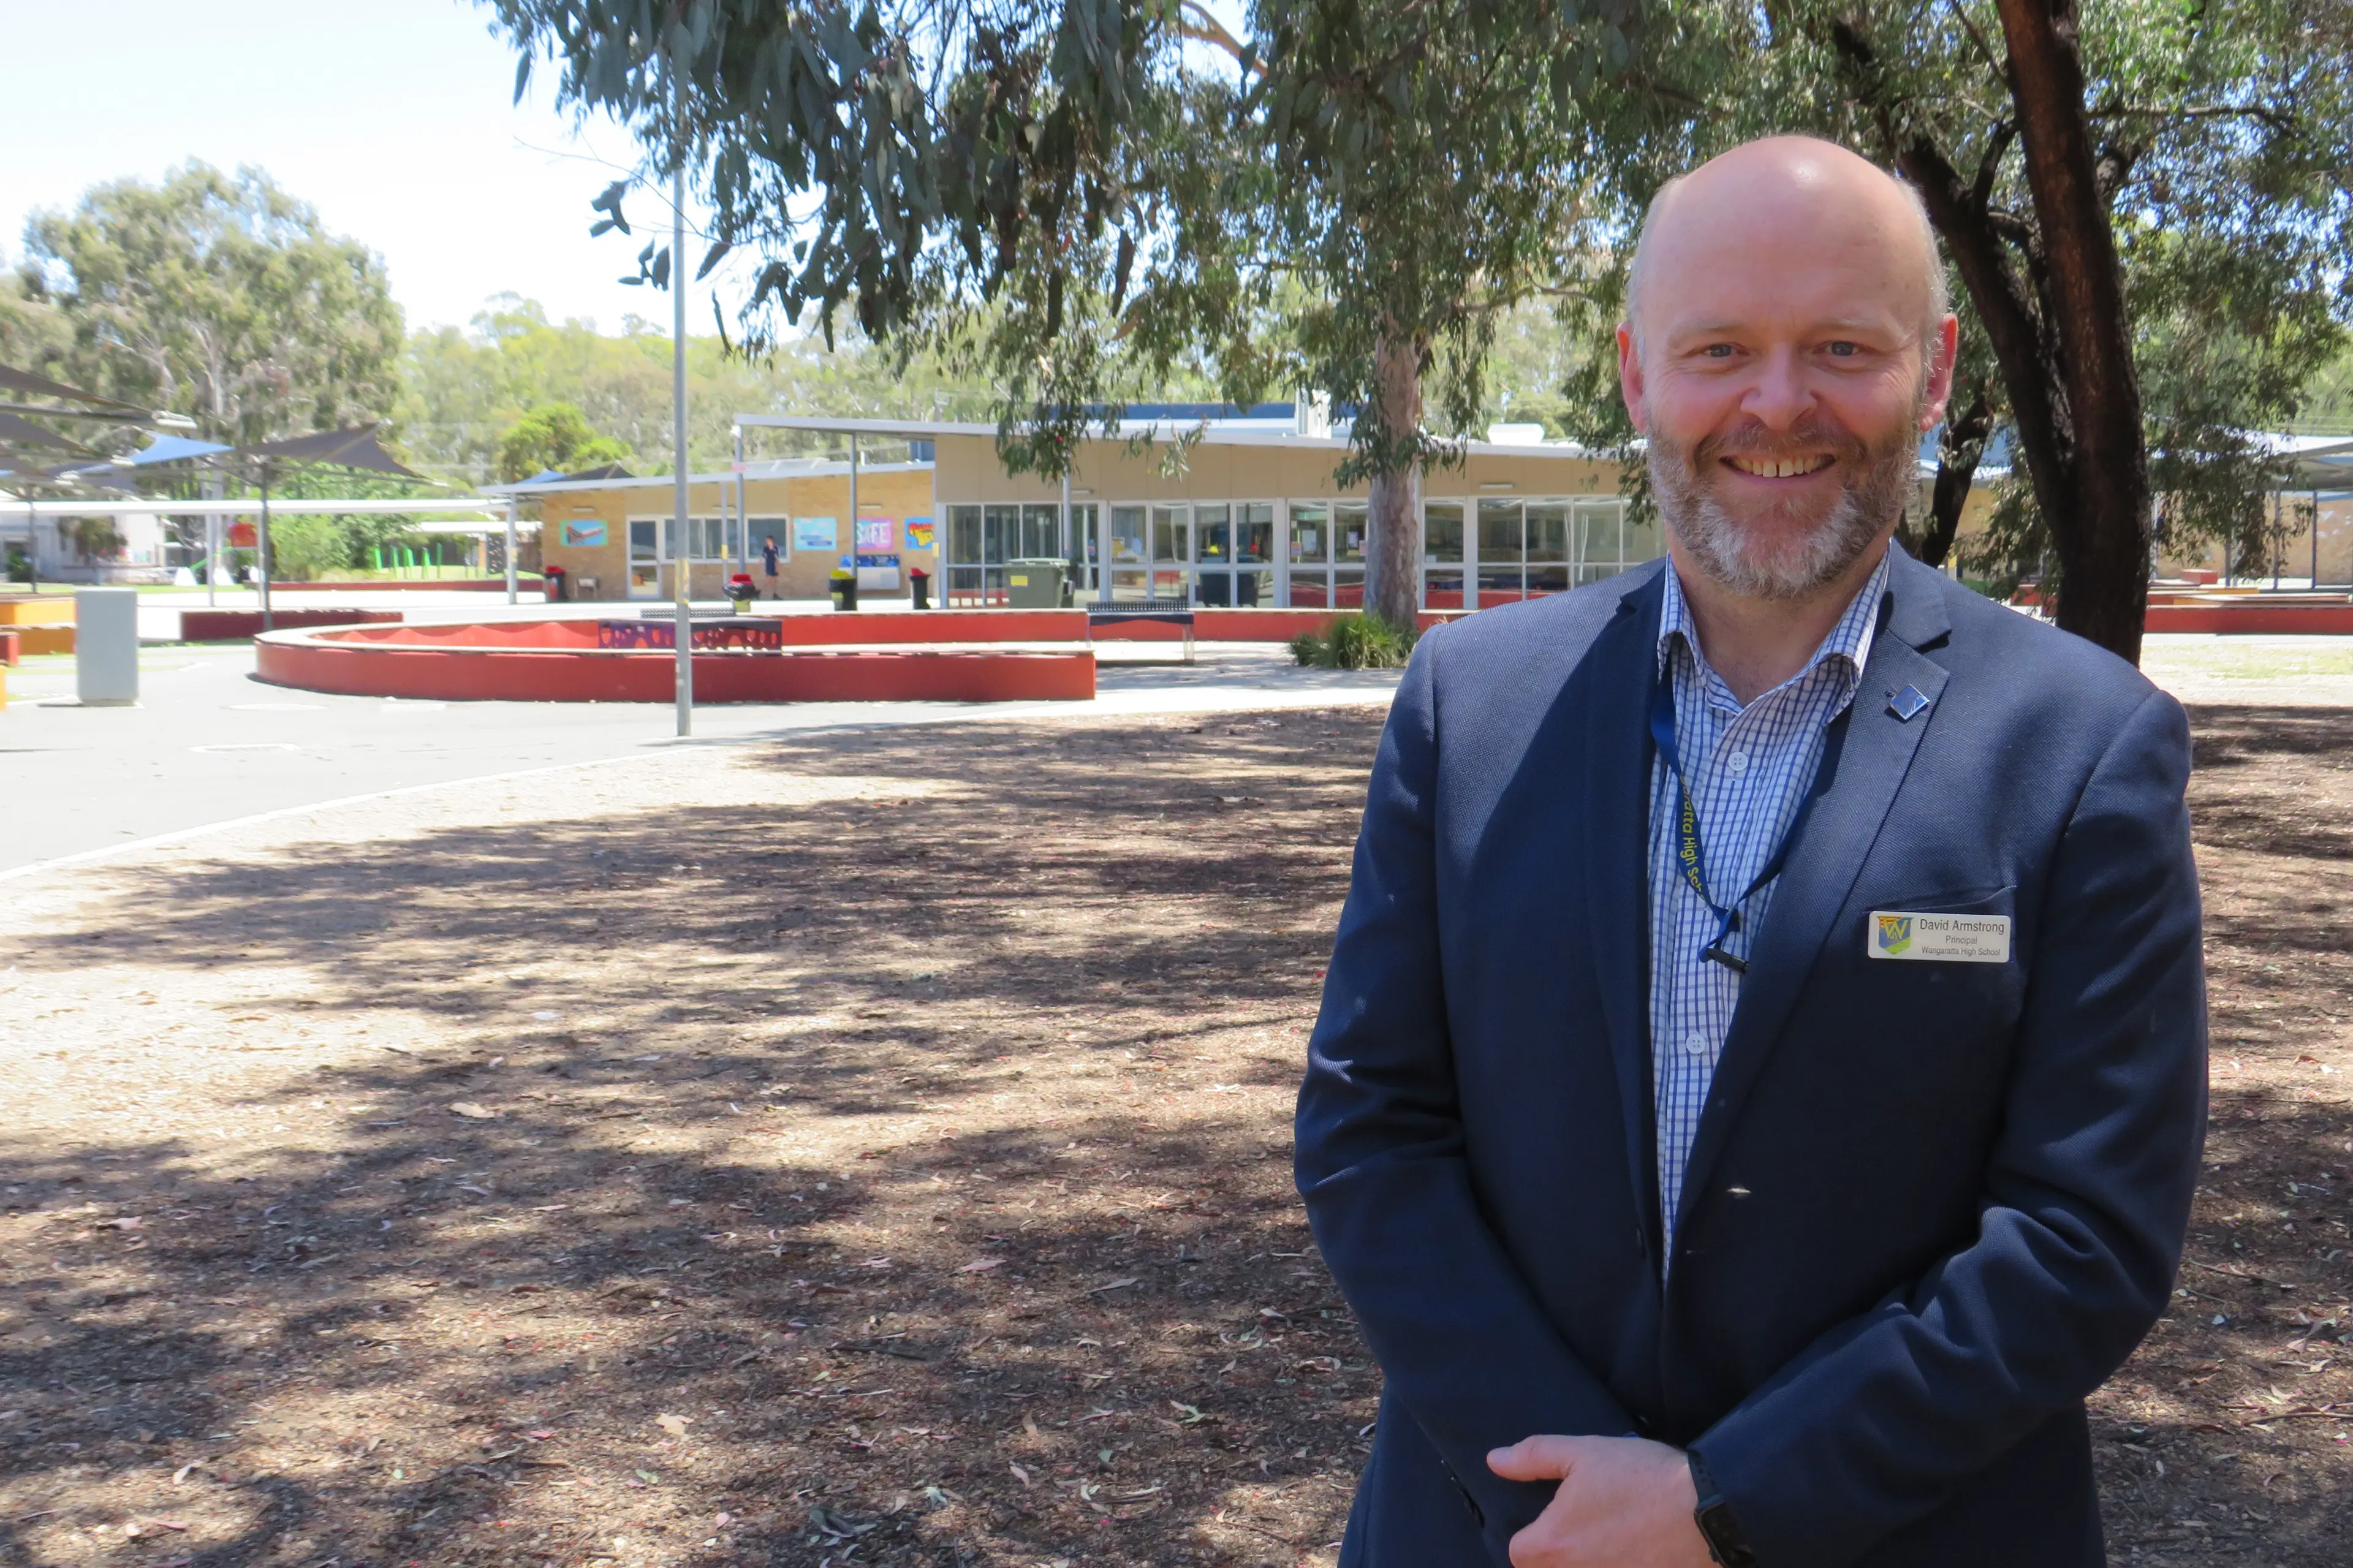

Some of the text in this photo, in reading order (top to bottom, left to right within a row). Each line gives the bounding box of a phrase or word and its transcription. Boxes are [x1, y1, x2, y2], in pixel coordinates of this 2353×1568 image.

[1680, 837, 1699, 866] High
[1920, 918, 2004, 935] David Armstrong
[1946, 935, 1977, 945] Principal
[1922, 946, 2001, 956] Wangaratta High School
